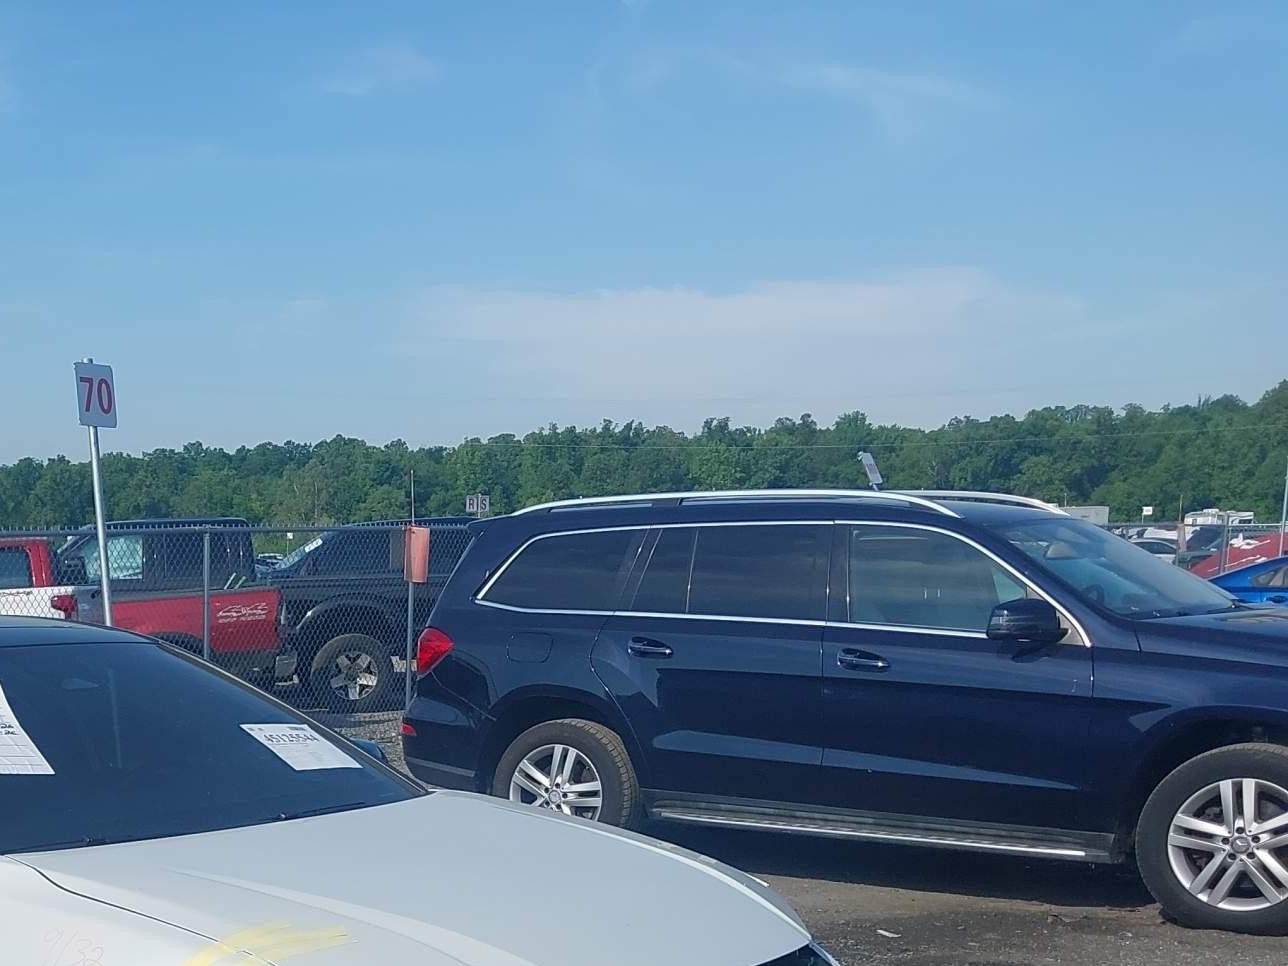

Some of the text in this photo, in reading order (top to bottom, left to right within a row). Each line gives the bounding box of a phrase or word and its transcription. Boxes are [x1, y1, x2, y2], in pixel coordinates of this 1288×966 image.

[79, 376, 113, 415] 70
[468, 498, 475, 510] R
[480, 498, 487, 510] S
